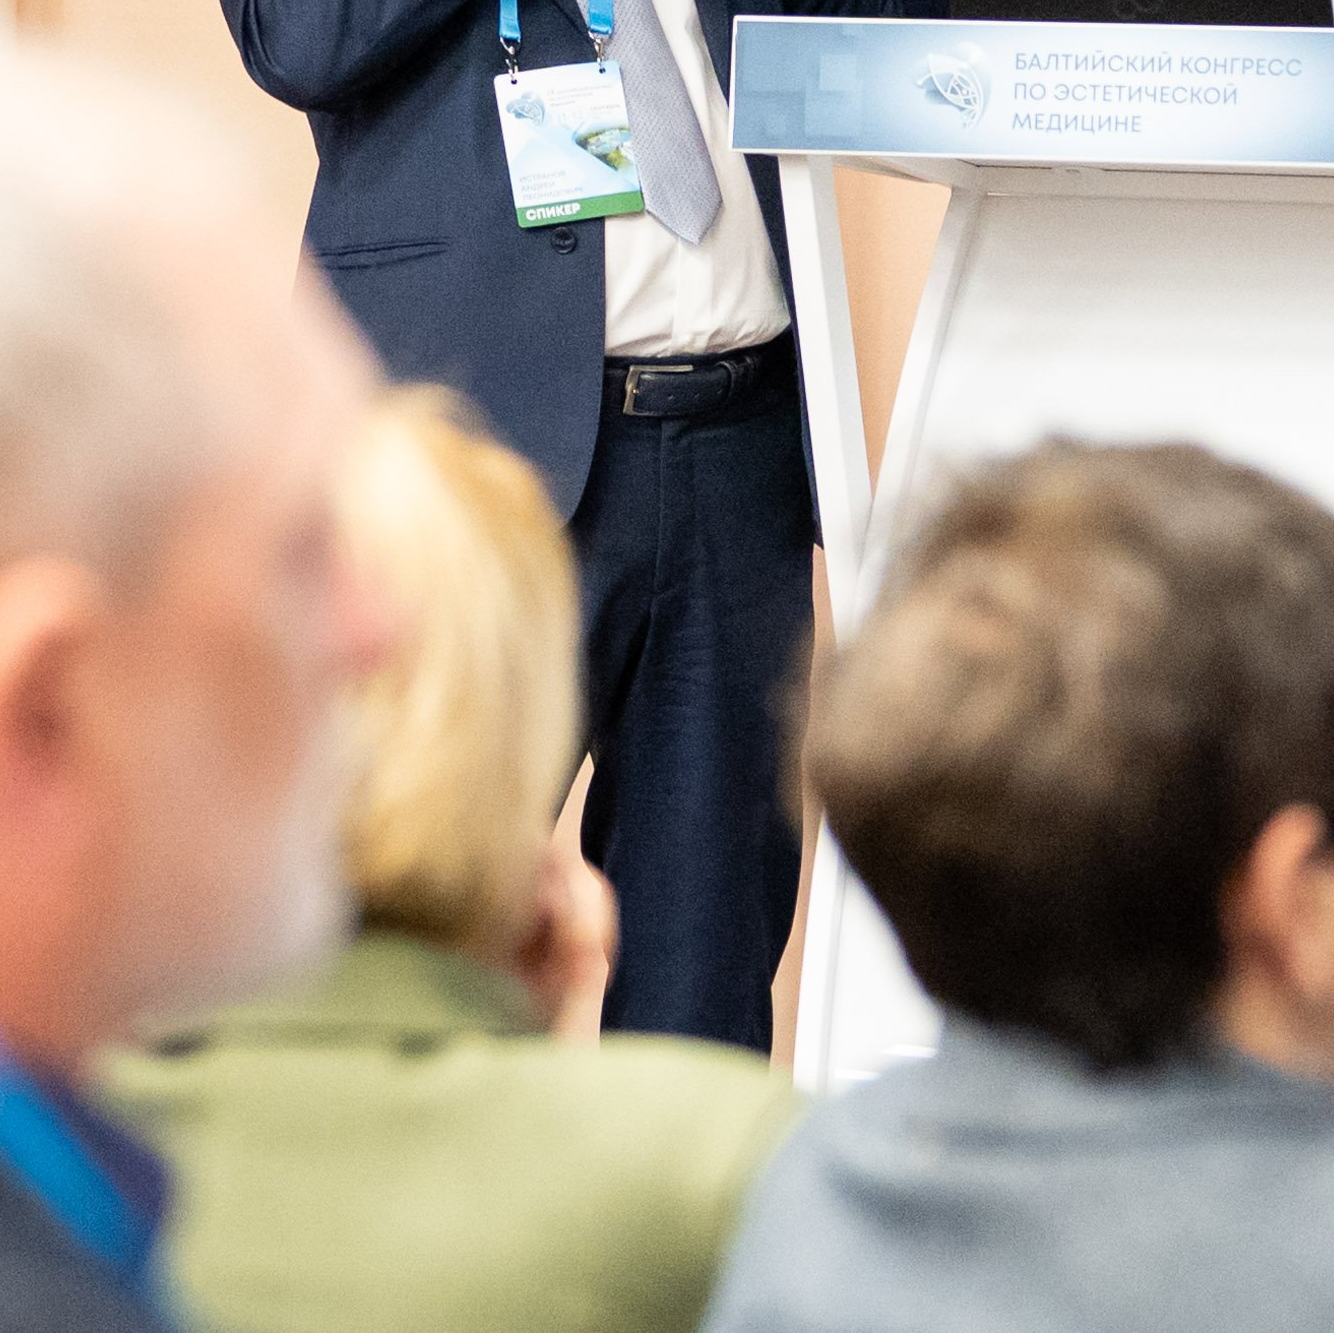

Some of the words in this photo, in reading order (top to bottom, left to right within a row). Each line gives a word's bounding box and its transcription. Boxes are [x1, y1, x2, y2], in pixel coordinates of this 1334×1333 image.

[1014, 50, 1173, 76] БАЛТИЙСКИЙ
[1180, 57, 1303, 77] КОНГРЕСС
[1013, 82, 1048, 101] ПО
[1053, 81, 1238, 106] ЭСТЕТИЧЕСКОЙ
[1011, 112, 1142, 135] МЕДИЦИНЕ
[526, 202, 581, 221] СПИКЕР
